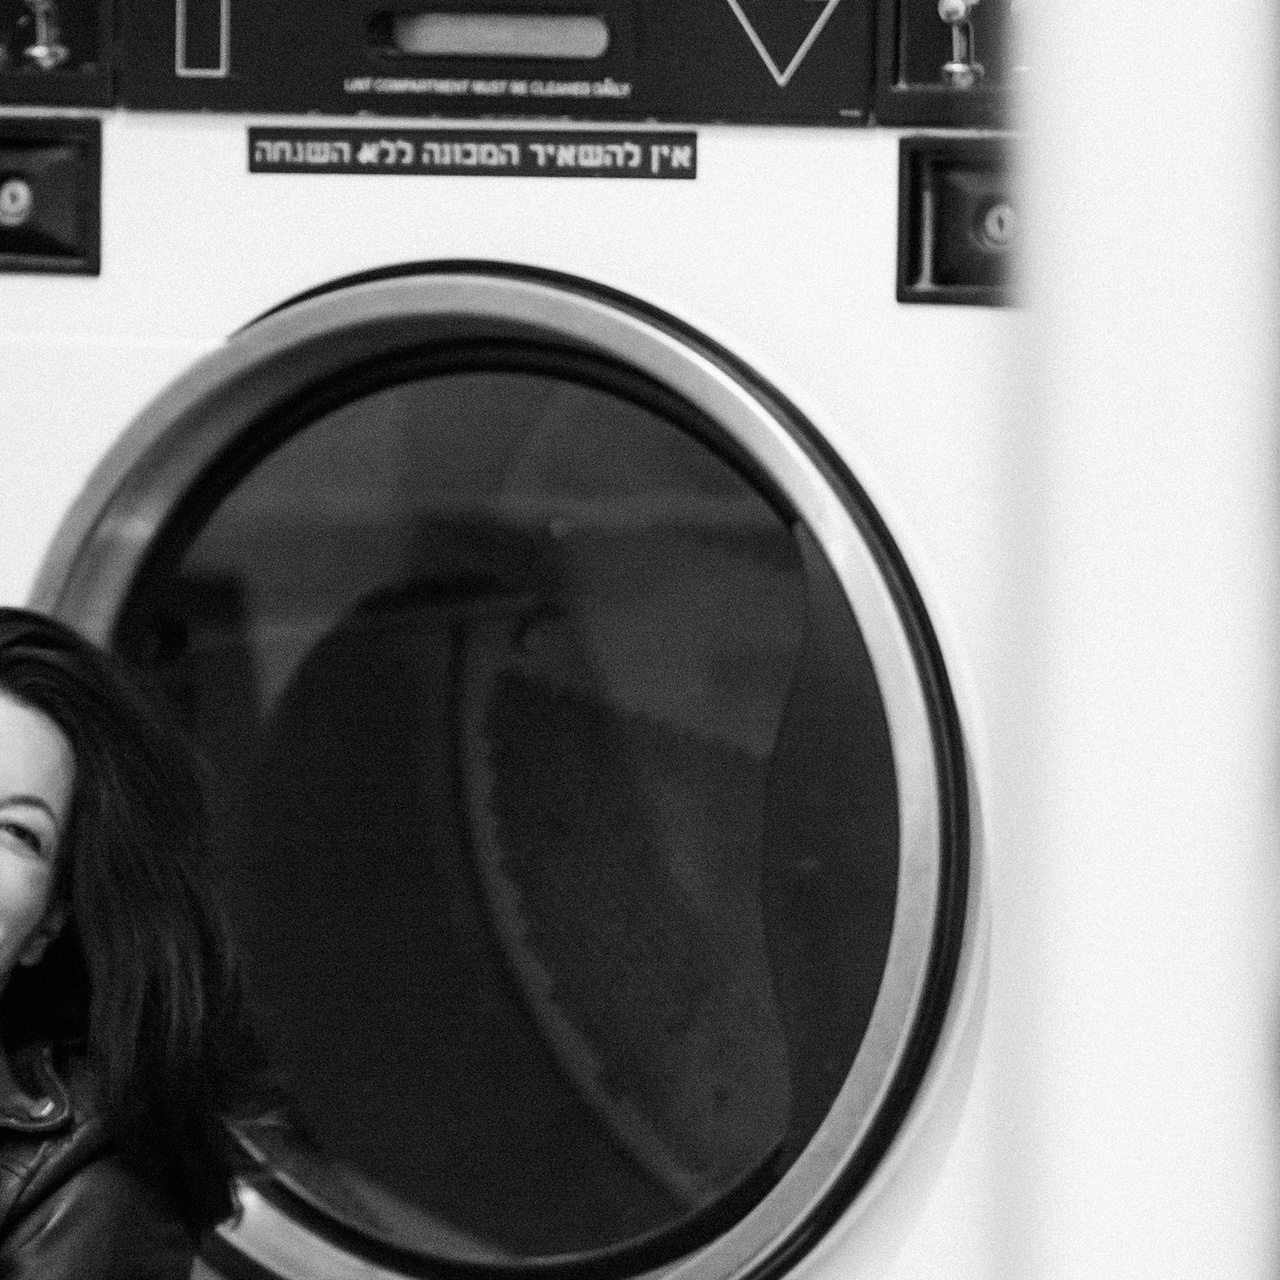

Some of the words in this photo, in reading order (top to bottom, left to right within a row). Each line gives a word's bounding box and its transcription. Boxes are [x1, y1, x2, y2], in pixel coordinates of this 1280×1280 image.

[356, 138, 415, 165] ללא
[422, 141, 519, 166] המכונה
[529, 140, 642, 168] להשאיר
[650, 143, 692, 173] אין
